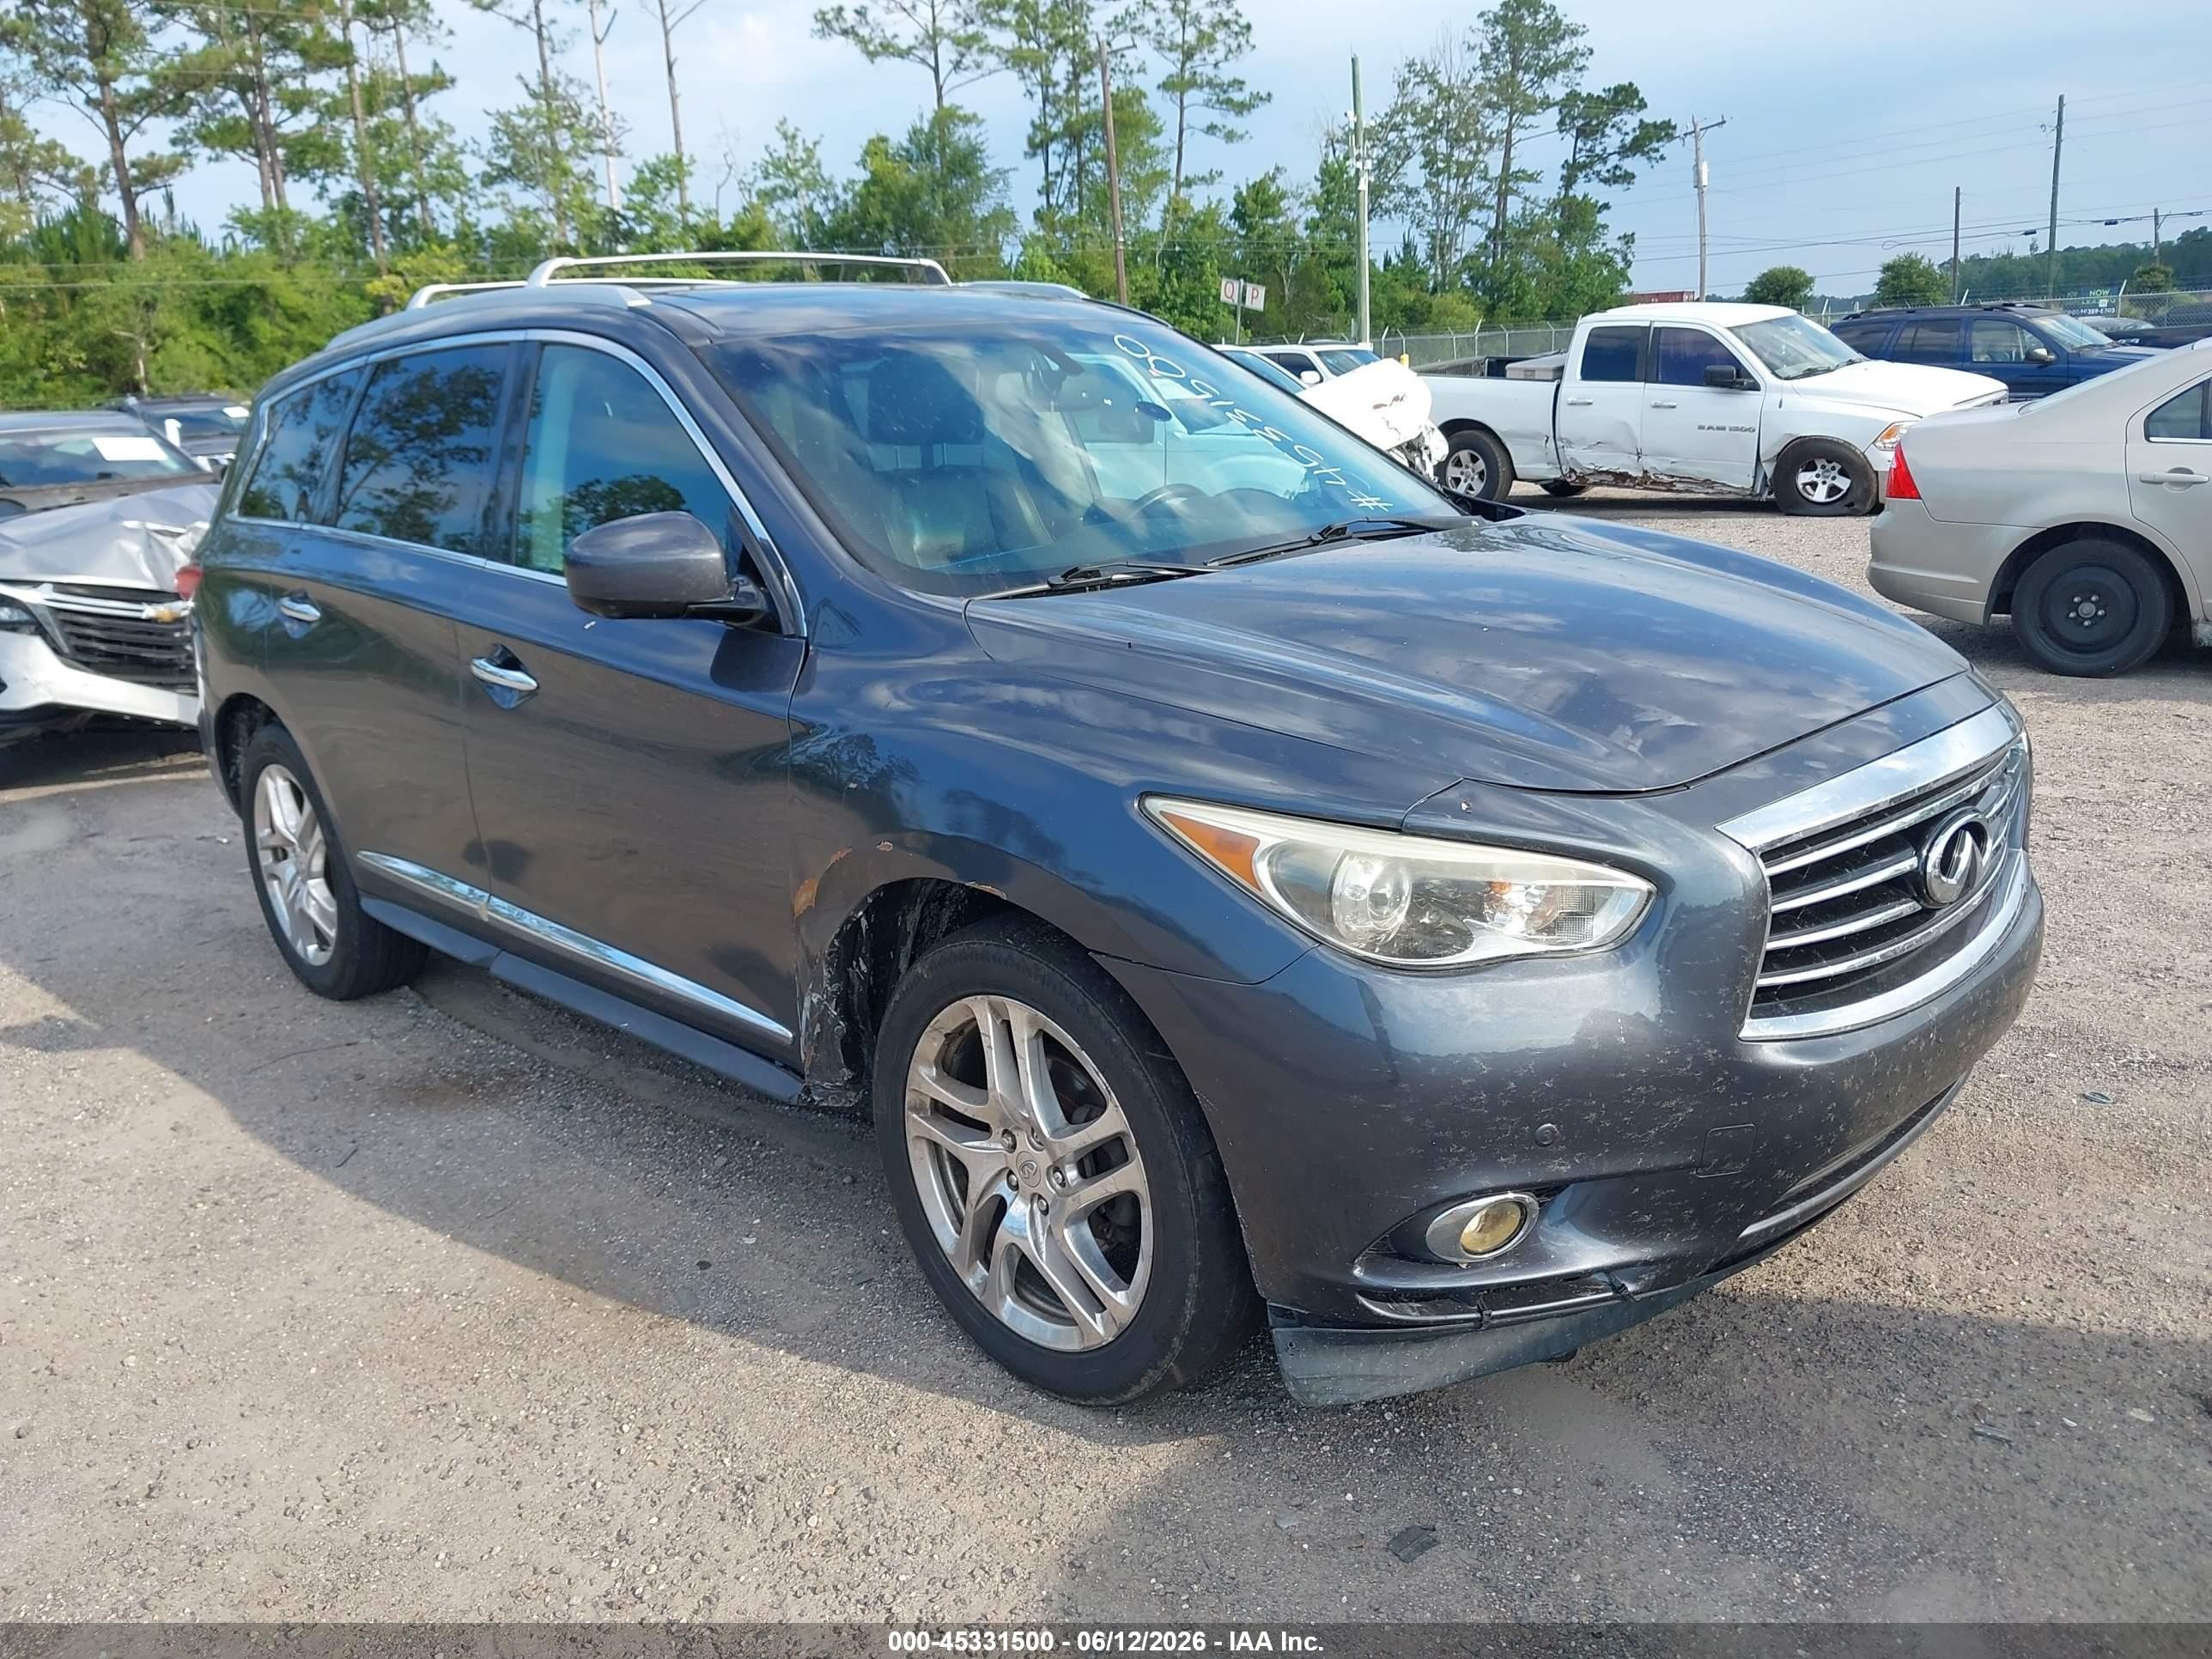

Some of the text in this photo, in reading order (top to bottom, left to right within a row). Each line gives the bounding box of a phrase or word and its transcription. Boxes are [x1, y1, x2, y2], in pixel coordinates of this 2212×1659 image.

[1224, 281, 1235, 303] Q
[1250, 287, 1260, 306] P
[2088, 288, 2111, 297] NOW
[1114, 334, 1394, 512] #45331500
